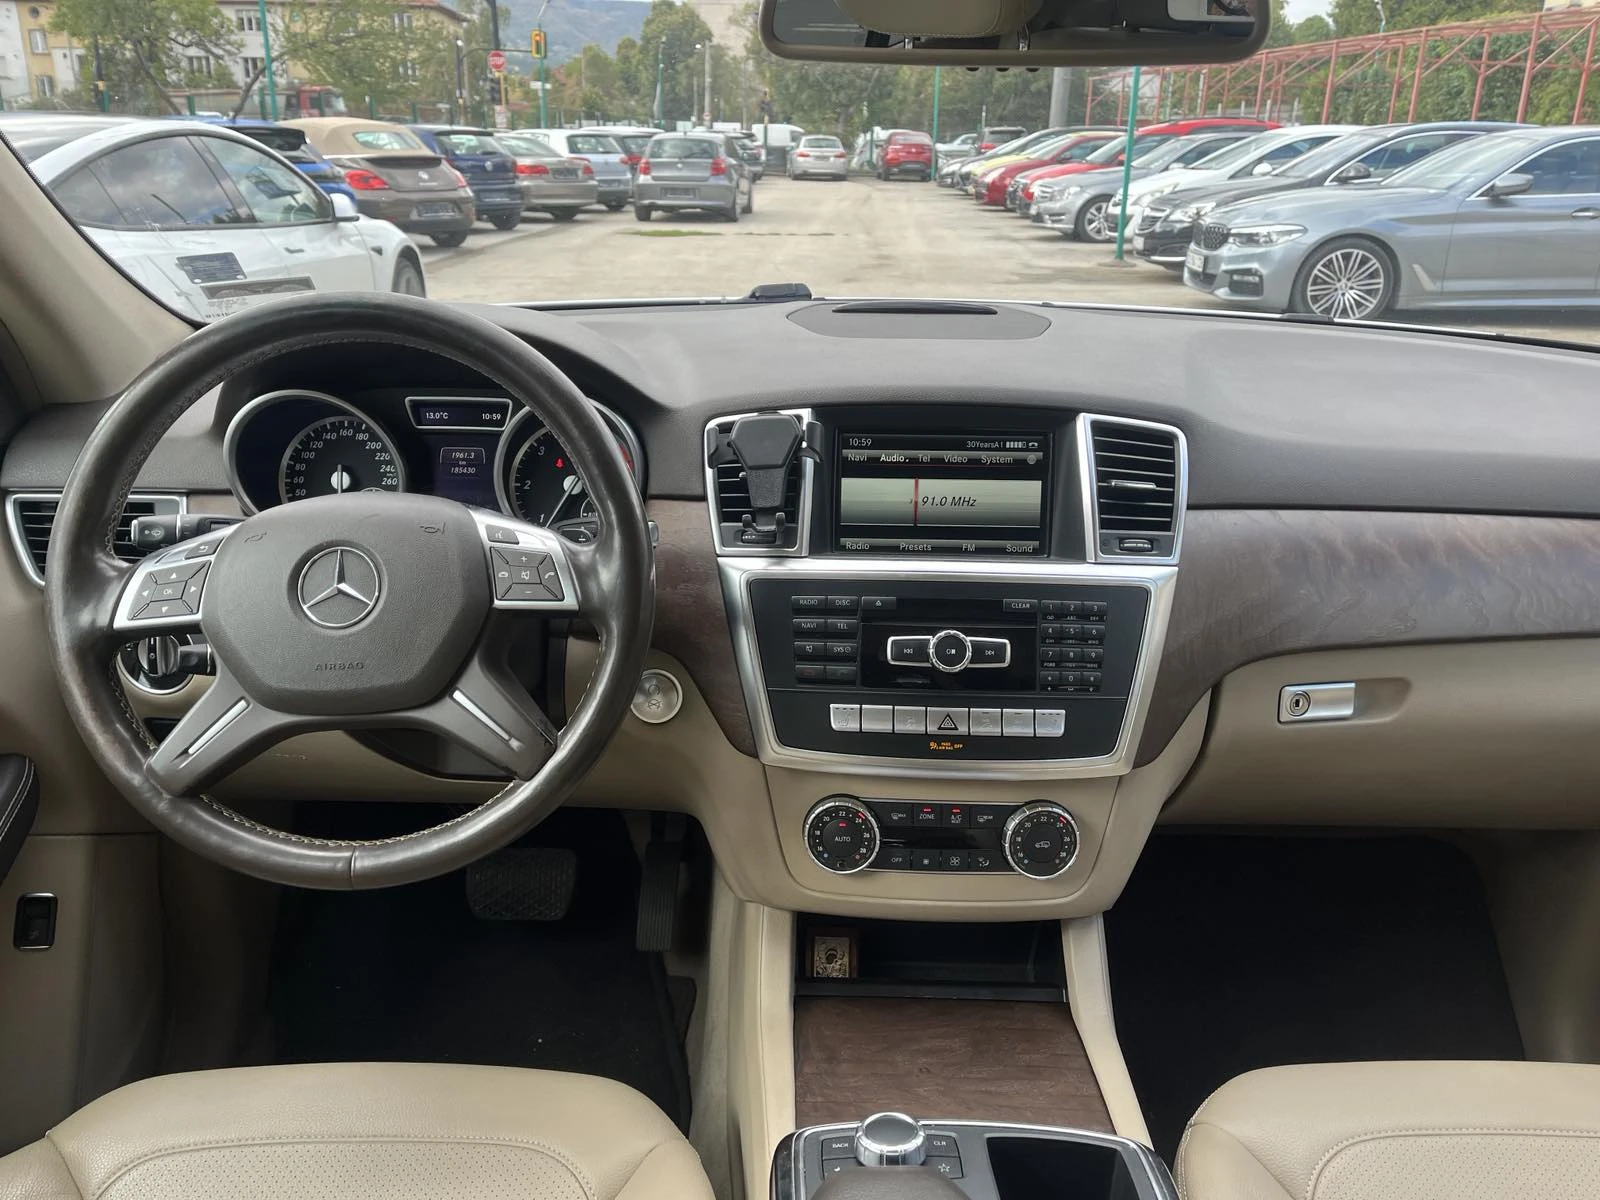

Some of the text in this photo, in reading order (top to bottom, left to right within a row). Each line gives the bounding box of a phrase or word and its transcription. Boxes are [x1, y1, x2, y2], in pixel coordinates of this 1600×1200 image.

[310, 441, 324, 449] 120
[849, 438, 872, 446] 10:59
[301, 451, 316, 459] 100
[538, 446, 545, 456] 3
[375, 452, 391, 460] 220
[918, 454, 931, 462] Tel
[943, 454, 968, 463] Video
[981, 456, 1013, 465] System
[294, 463, 306, 471] 80
[293, 476, 305, 484] 60
[382, 477, 398, 486] 260
[523, 480, 531, 490] 2
[295, 488, 306, 496] 50
[921, 496, 977, 507] 91.0 MHz
[539, 513, 545, 523] 1
[846, 541, 1033, 553] Radio Presets FM Sound
[314, 661, 364, 671] AIRBAG
